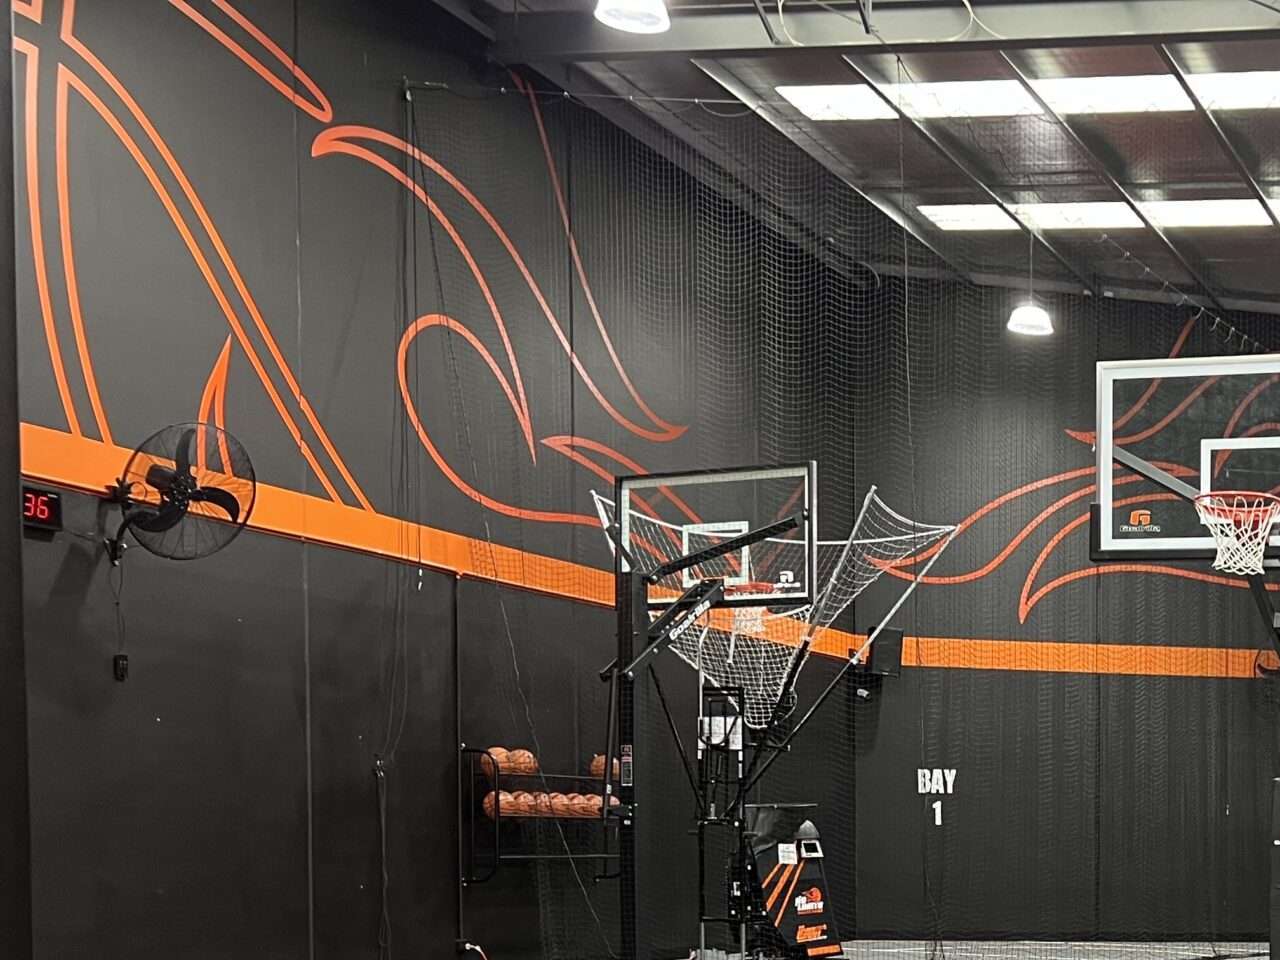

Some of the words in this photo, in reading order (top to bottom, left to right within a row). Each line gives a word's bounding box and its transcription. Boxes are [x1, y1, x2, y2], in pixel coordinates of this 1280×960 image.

[23, 493, 49, 519] 36
[917, 768, 957, 794] BAY
[932, 800, 942, 826] 1
